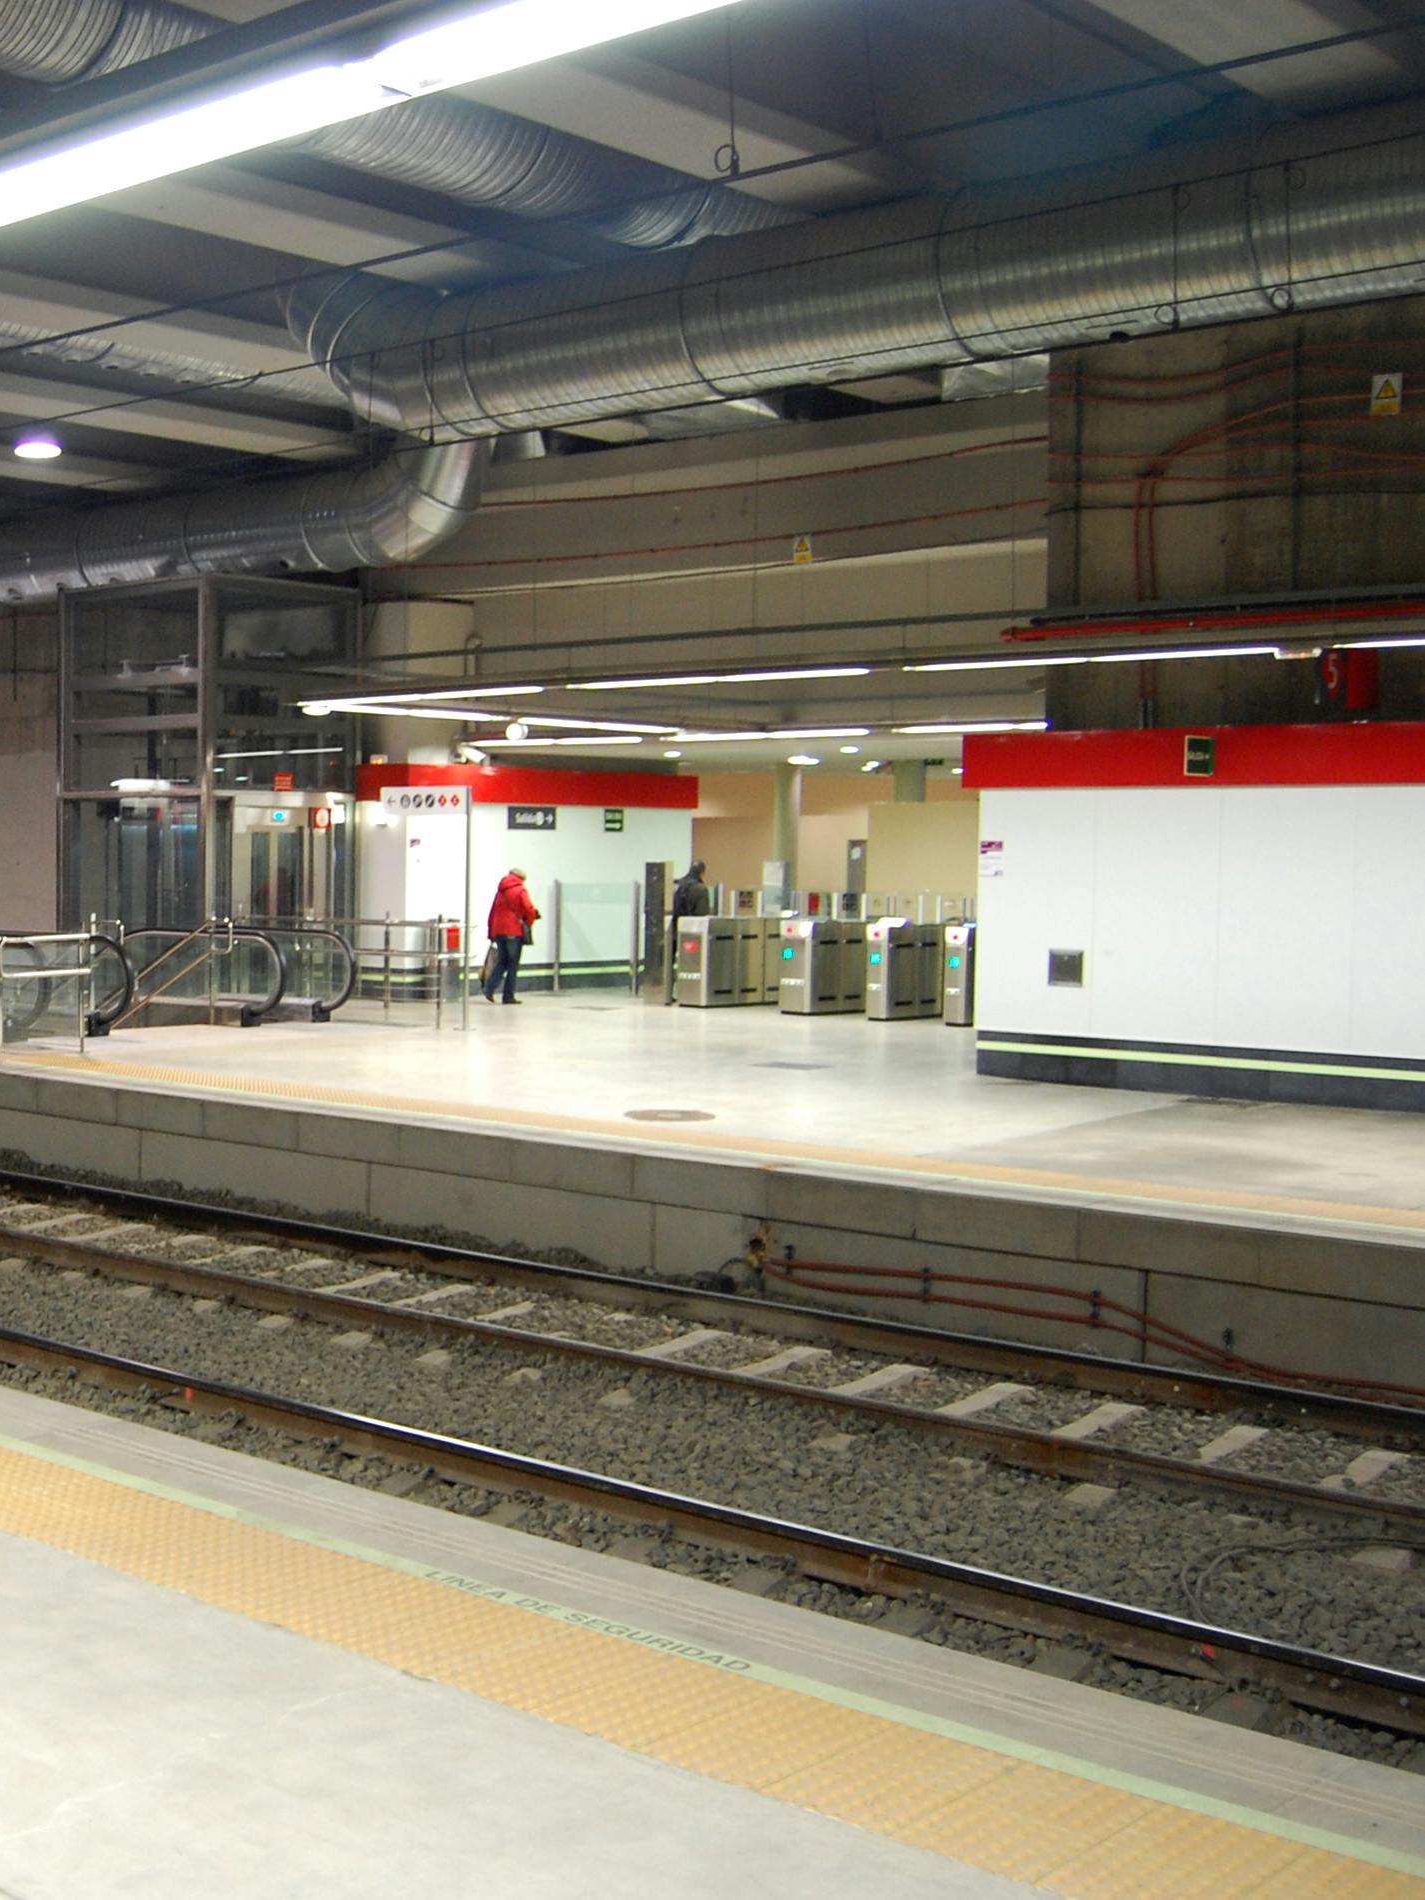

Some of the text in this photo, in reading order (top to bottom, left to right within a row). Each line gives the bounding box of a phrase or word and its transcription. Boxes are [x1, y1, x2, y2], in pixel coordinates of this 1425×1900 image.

[1328, 653, 1338, 690] 5
[424, 1570, 752, 1672] LINEA DE SEGURIDAD
